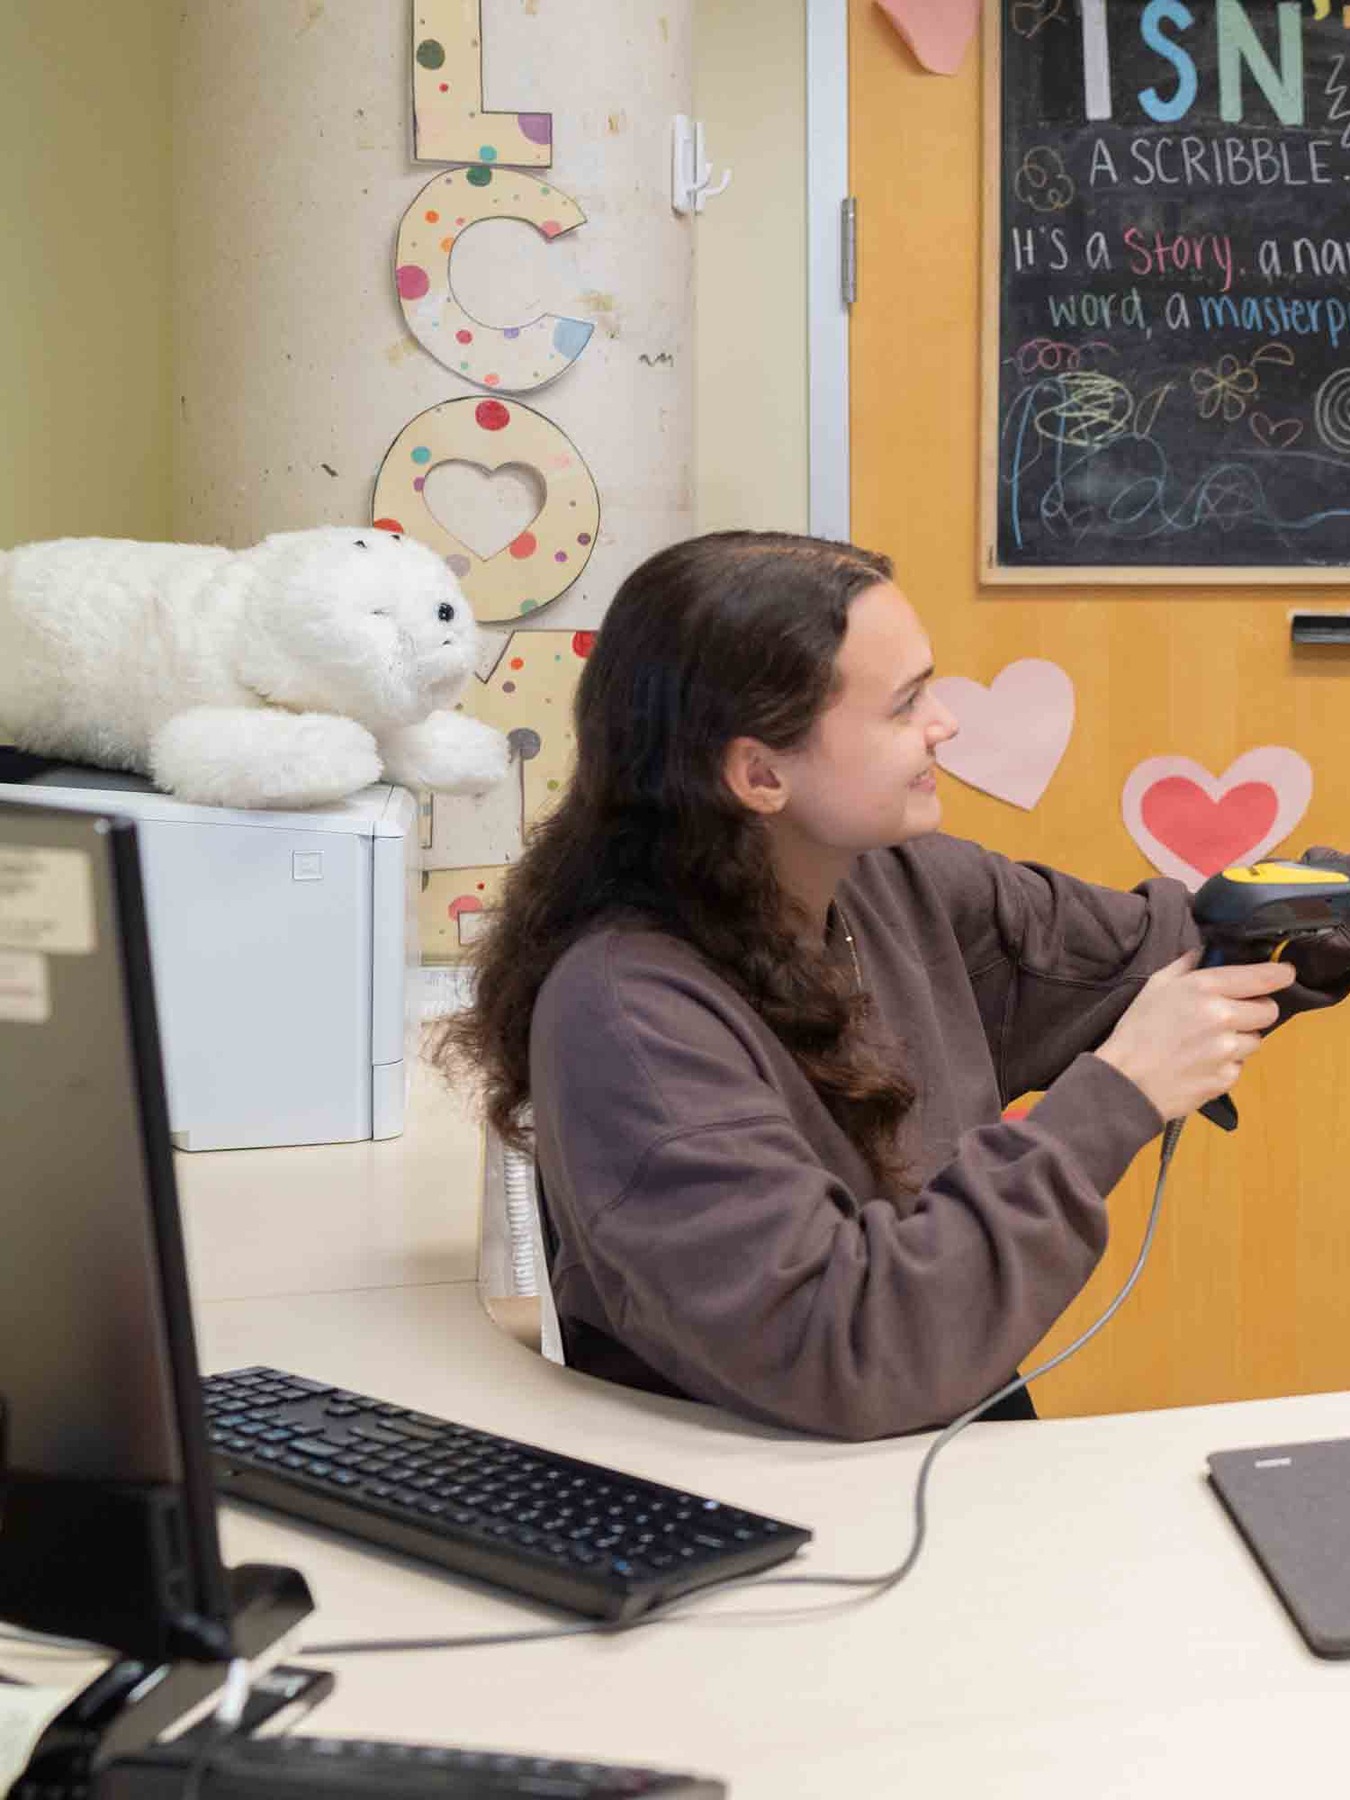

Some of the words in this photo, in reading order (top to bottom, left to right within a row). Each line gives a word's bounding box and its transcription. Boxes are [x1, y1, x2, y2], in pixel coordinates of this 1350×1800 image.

[1089, 139, 1119, 187] A
[1085, 230, 1112, 271] a
[1258, 238, 1282, 276] a
[1164, 292, 1190, 331] a
